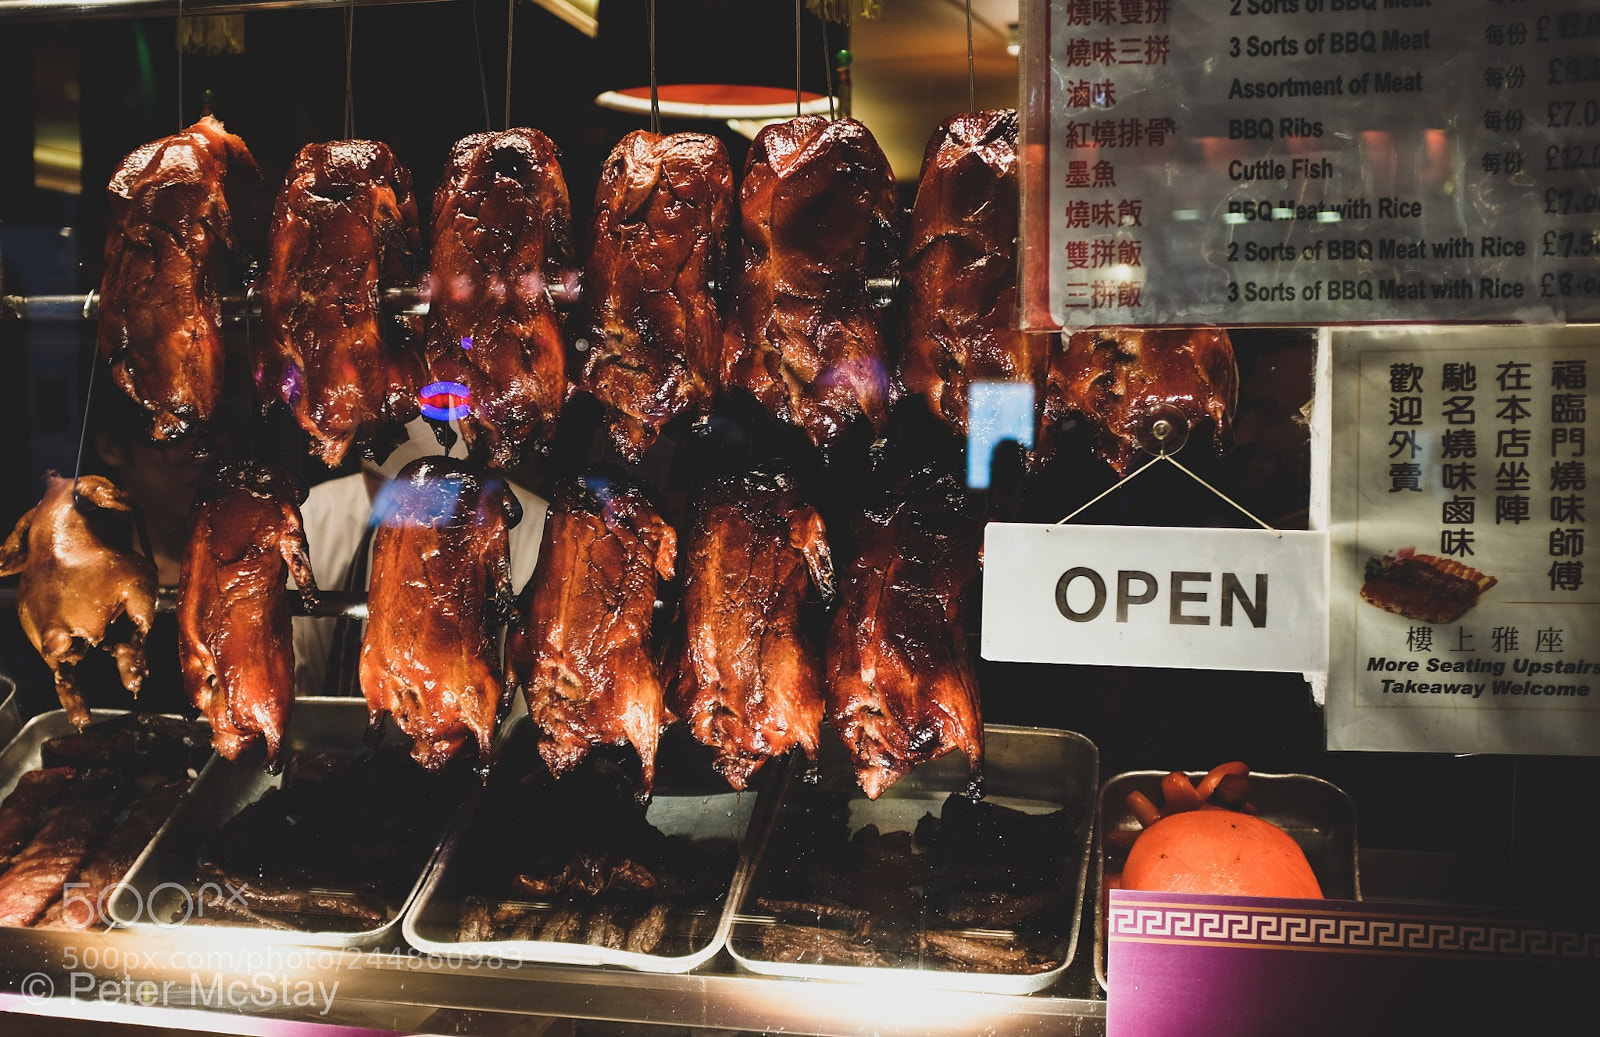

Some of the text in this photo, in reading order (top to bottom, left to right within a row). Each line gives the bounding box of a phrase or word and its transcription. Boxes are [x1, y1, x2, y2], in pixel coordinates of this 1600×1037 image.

[1230, 0, 1241, 16] 2
[1247, 0, 1299, 15] Sorts
[1230, 29, 1431, 58] 3 Sorts of BBQ Meat
[1485, 22, 1528, 46] 每份
[1066, 35, 1171, 67] 燒味三拼
[1229, 71, 1423, 99] Assortment of Meat
[1483, 65, 1526, 89] 每份
[1483, 108, 1525, 132] 每份
[1547, 98, 1600, 128] £7.0
[1066, 119, 1169, 148] 紅燒排骨
[1228, 117, 1323, 140] BBQ Ribs
[1066, 160, 1117, 188] 墨魚
[1228, 158, 1333, 181] Cuttle Fish
[1481, 151, 1524, 175] 每份
[1065, 199, 1142, 229] 燒味飯
[1330, 198, 1372, 219] with
[1378, 197, 1422, 219] Rice
[1065, 240, 1142, 269] 雙拼飯
[1227, 236, 1526, 262] 2 Sorts of BBQ Meat with Rice
[1065, 280, 1142, 309] 三拼飯
[1227, 278, 1525, 302] 3 Sorts of BBQ Meat with Rice
[1388, 363, 1423, 492] 歡迎外賣
[1495, 361, 1532, 525] 在本店坐陣
[1055, 566, 1268, 628] OPEN
[1406, 626, 1565, 653] 樓上雅座
[1367, 657, 1600, 677] More Seating Upstairs
[1381, 679, 1590, 698] Takeaway Welcome
